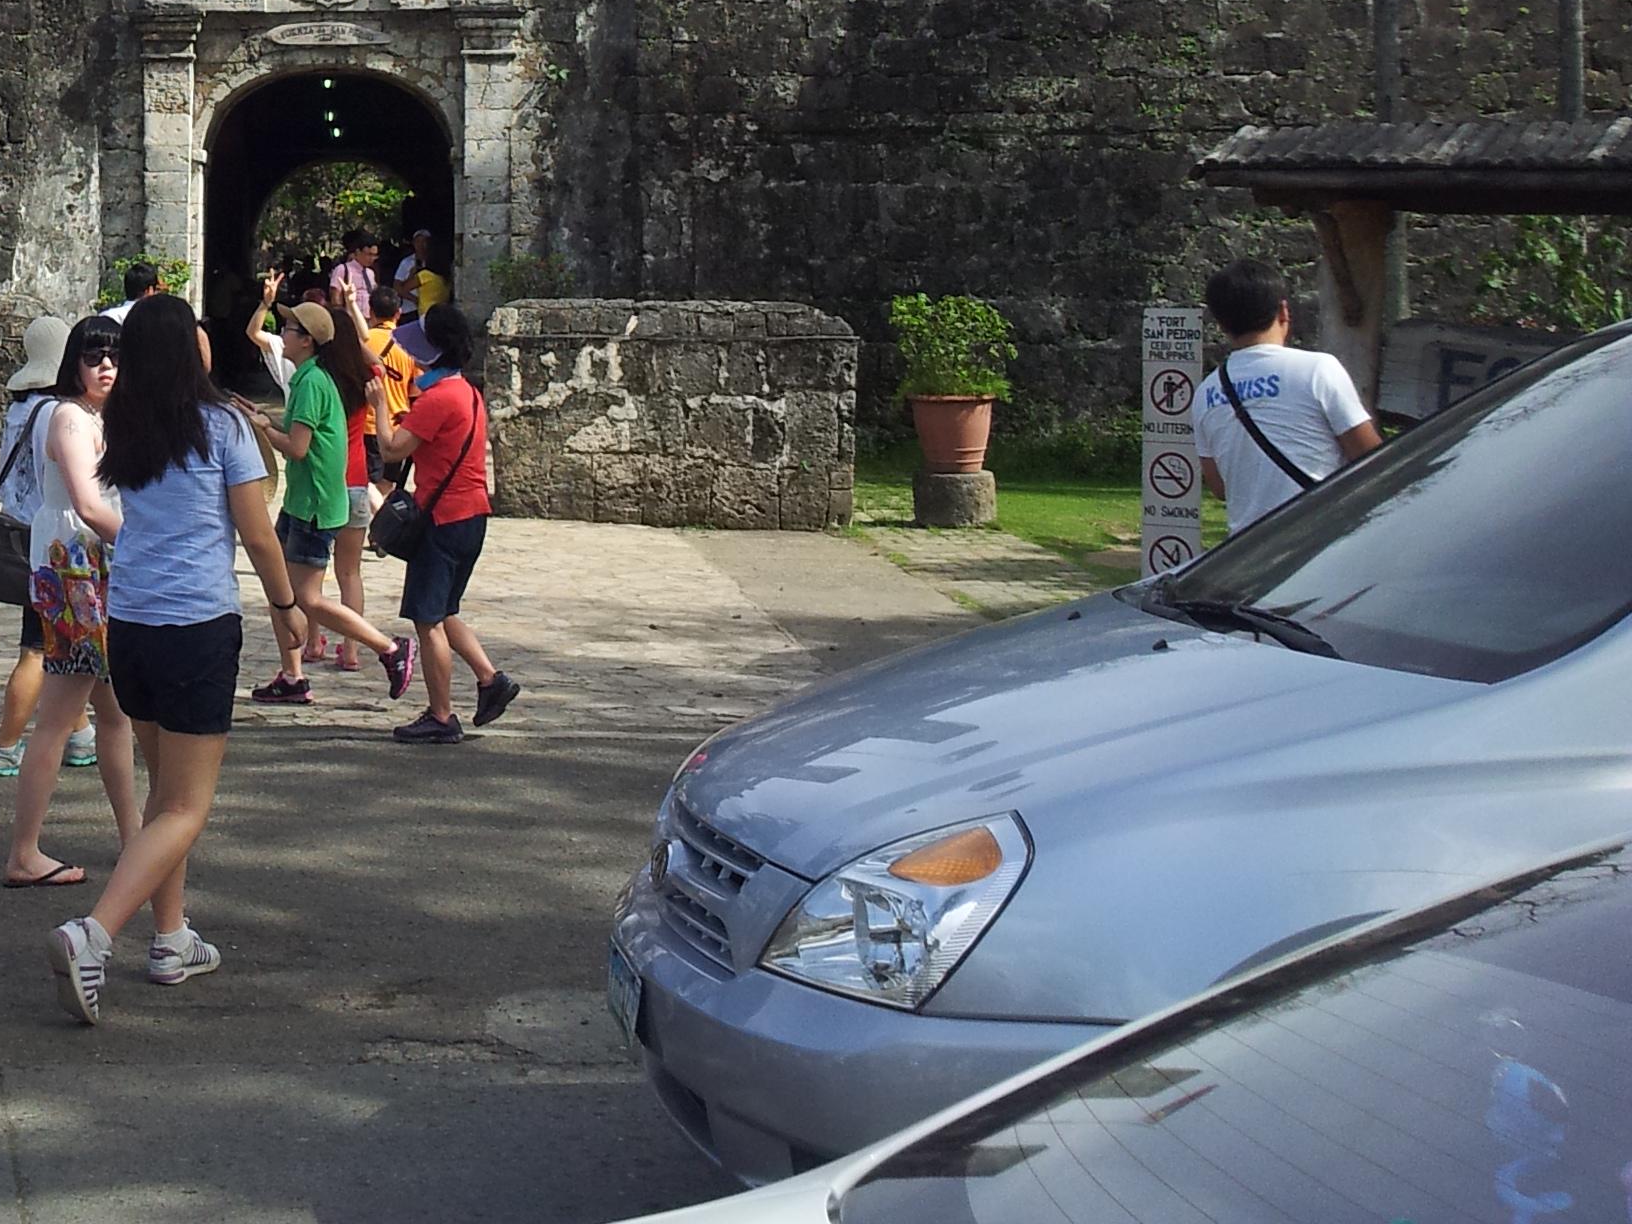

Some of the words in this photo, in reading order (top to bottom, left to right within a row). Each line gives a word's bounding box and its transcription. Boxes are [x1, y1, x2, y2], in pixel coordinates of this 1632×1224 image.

[1159, 316, 1186, 328] FORT
[1144, 329, 1164, 339] SAN
[1167, 329, 1201, 340] PEDRO
[1150, 341, 1171, 350] CEBU
[1175, 342, 1193, 350] CITY
[1149, 351, 1195, 361] PHILIPPINES
[1143, 422, 1155, 433] NO
[1144, 505, 1156, 516] NO
[1161, 506, 1199, 519] SMOKING
